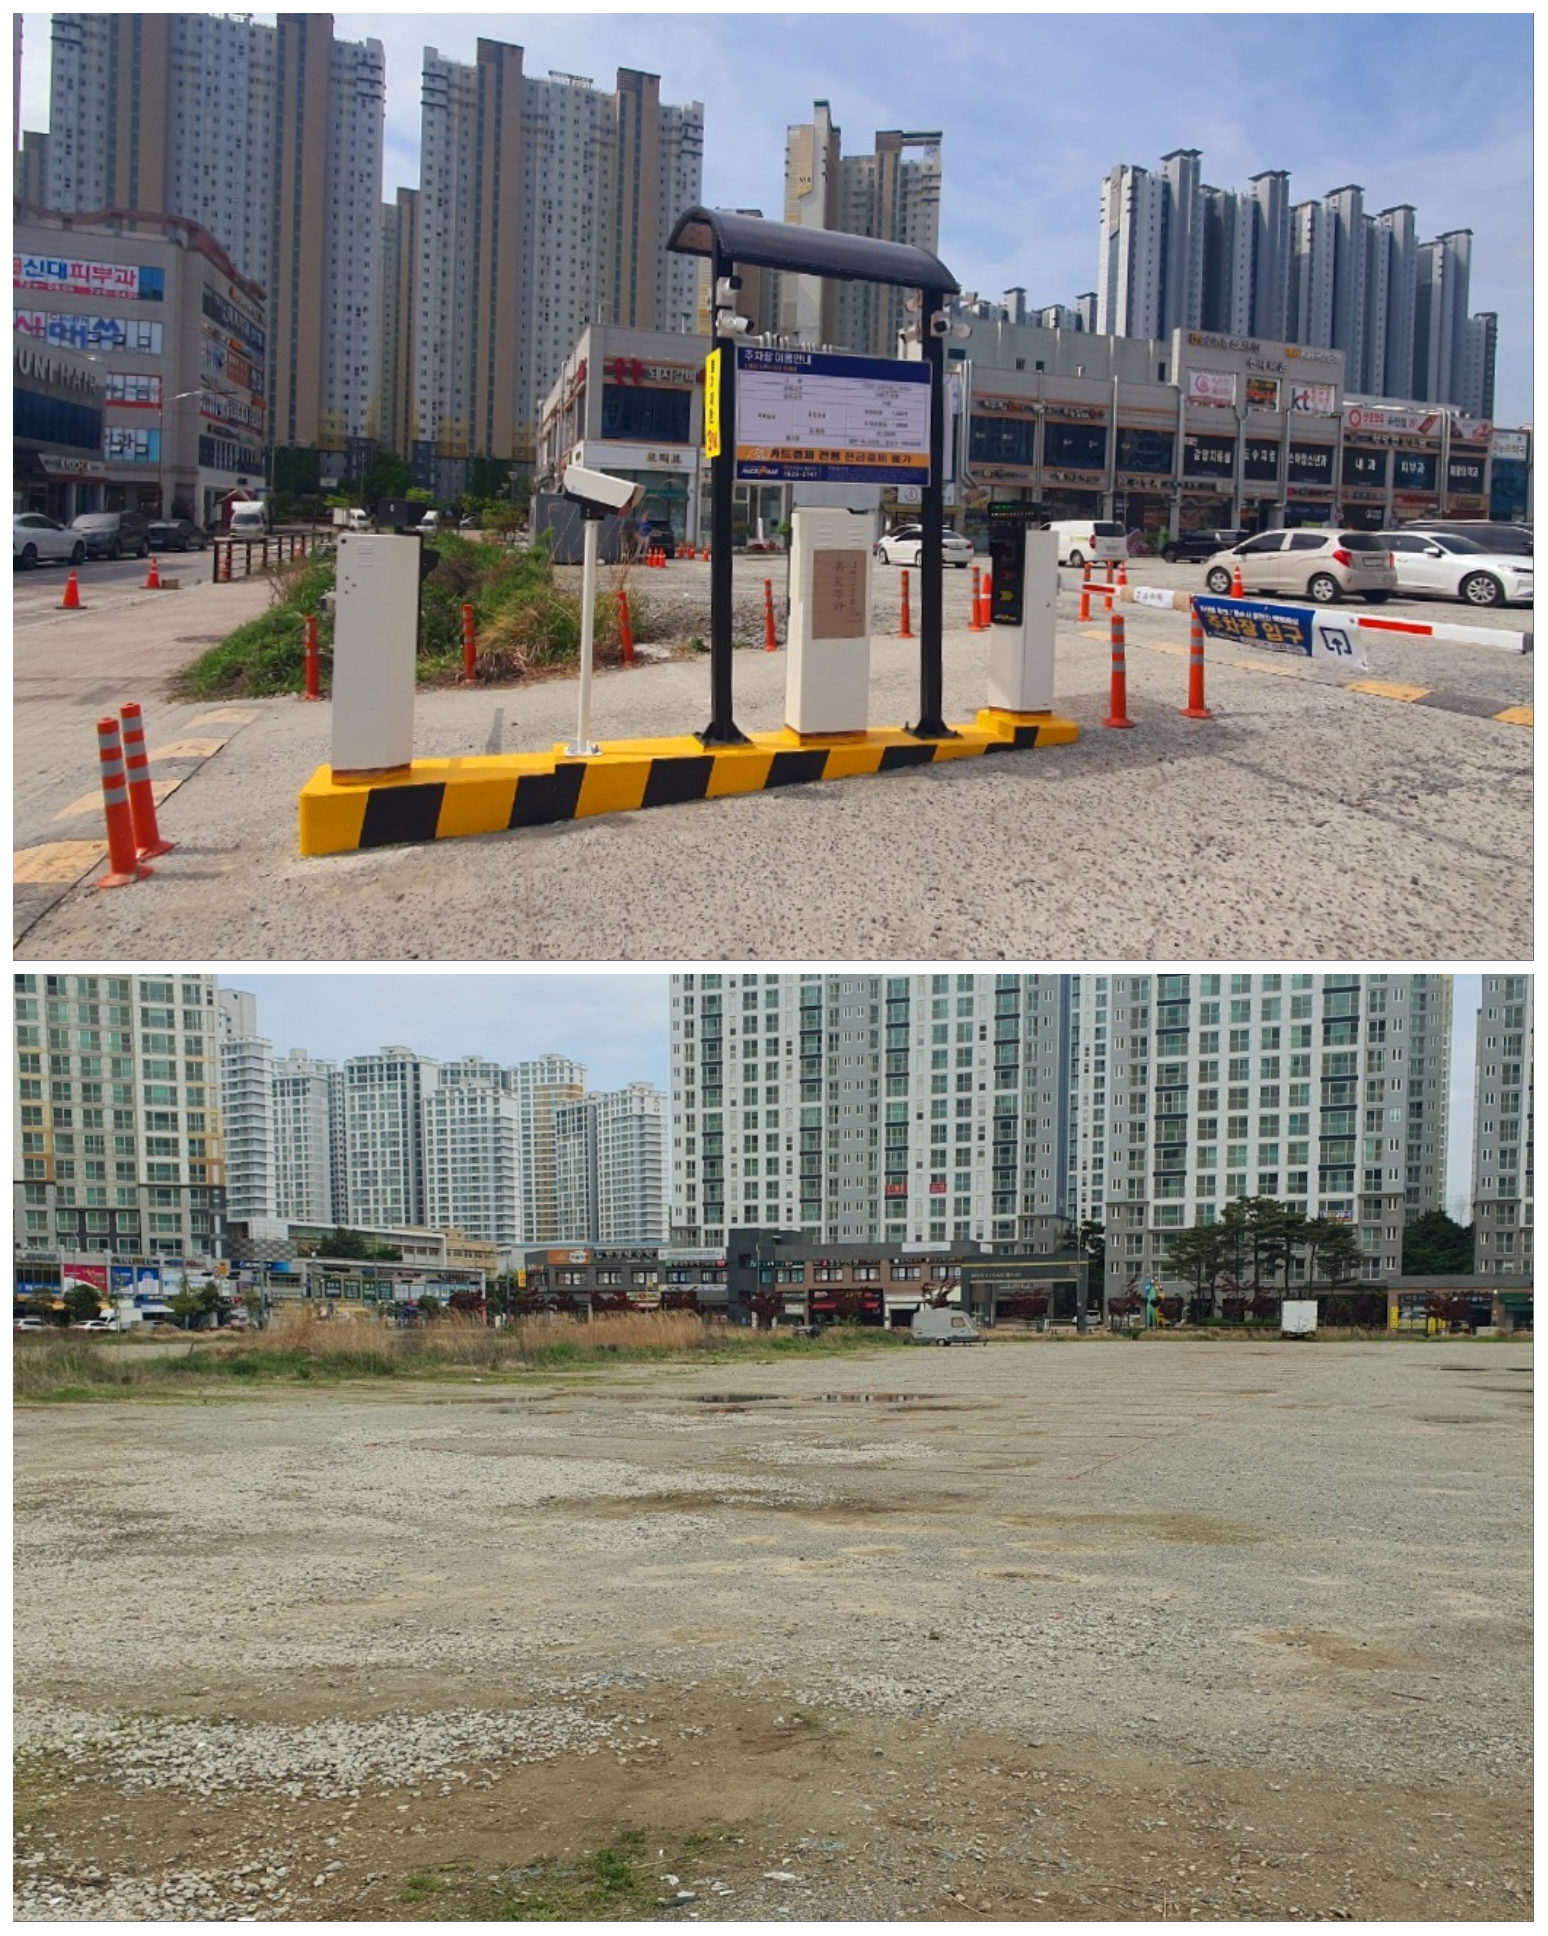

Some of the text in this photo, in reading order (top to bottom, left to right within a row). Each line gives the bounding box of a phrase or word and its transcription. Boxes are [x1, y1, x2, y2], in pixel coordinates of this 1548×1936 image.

[24, 257, 136, 287] 신대피부과
[744, 350, 812, 365] 주차장 이용안내
[1291, 387, 1310, 411] kt
[1401, 460, 1426, 475] 피부과
[1206, 614, 1258, 638] 주차장
[1261, 621, 1304, 644] 입구
